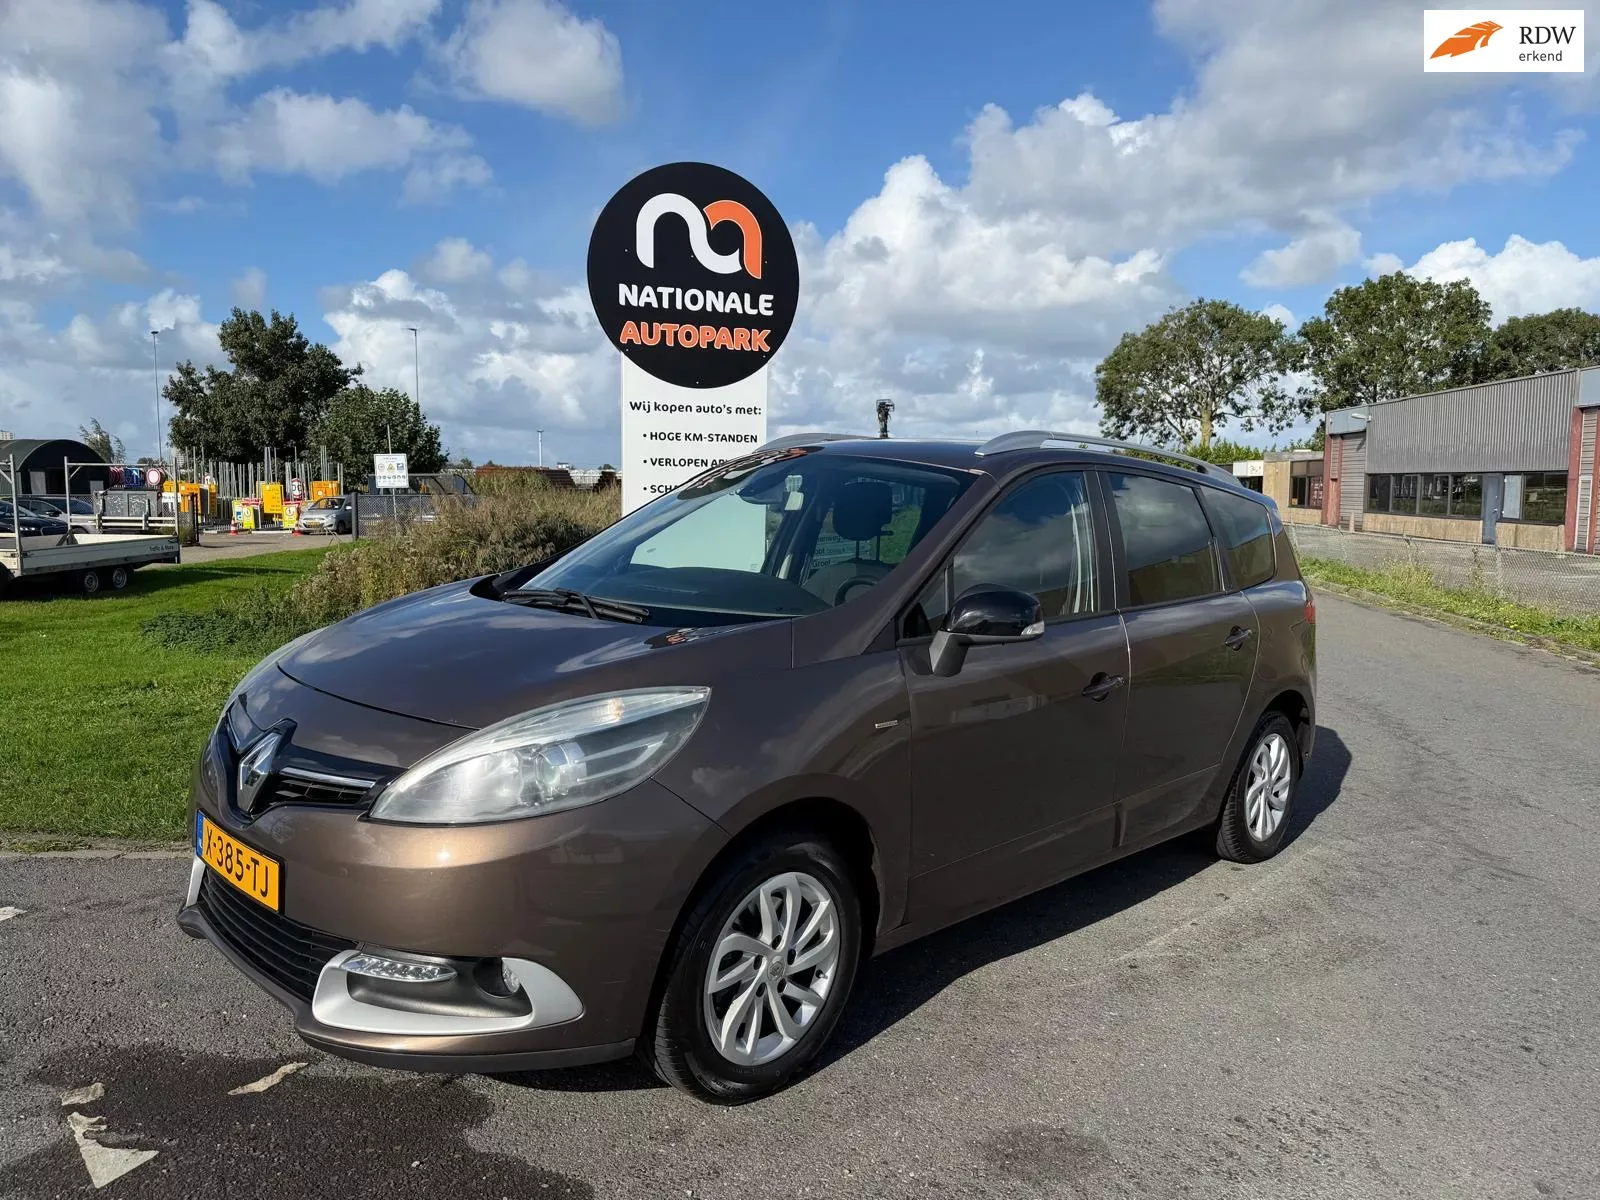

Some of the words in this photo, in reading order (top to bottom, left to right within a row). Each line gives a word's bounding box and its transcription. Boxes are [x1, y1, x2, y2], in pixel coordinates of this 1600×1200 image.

[618, 283, 774, 316] NATIONALE
[619, 320, 771, 352] AUTOPARK
[629, 401, 650, 413] Wij
[654, 402, 692, 414] kopen
[695, 404, 732, 415] auto's
[735, 406, 762, 415] met:
[650, 432, 681, 441] HOGE
[684, 433, 758, 443] KM-STANDEN
[650, 458, 708, 467] VERLOPEN
[205, 826, 268, 897] X-385-TJ
